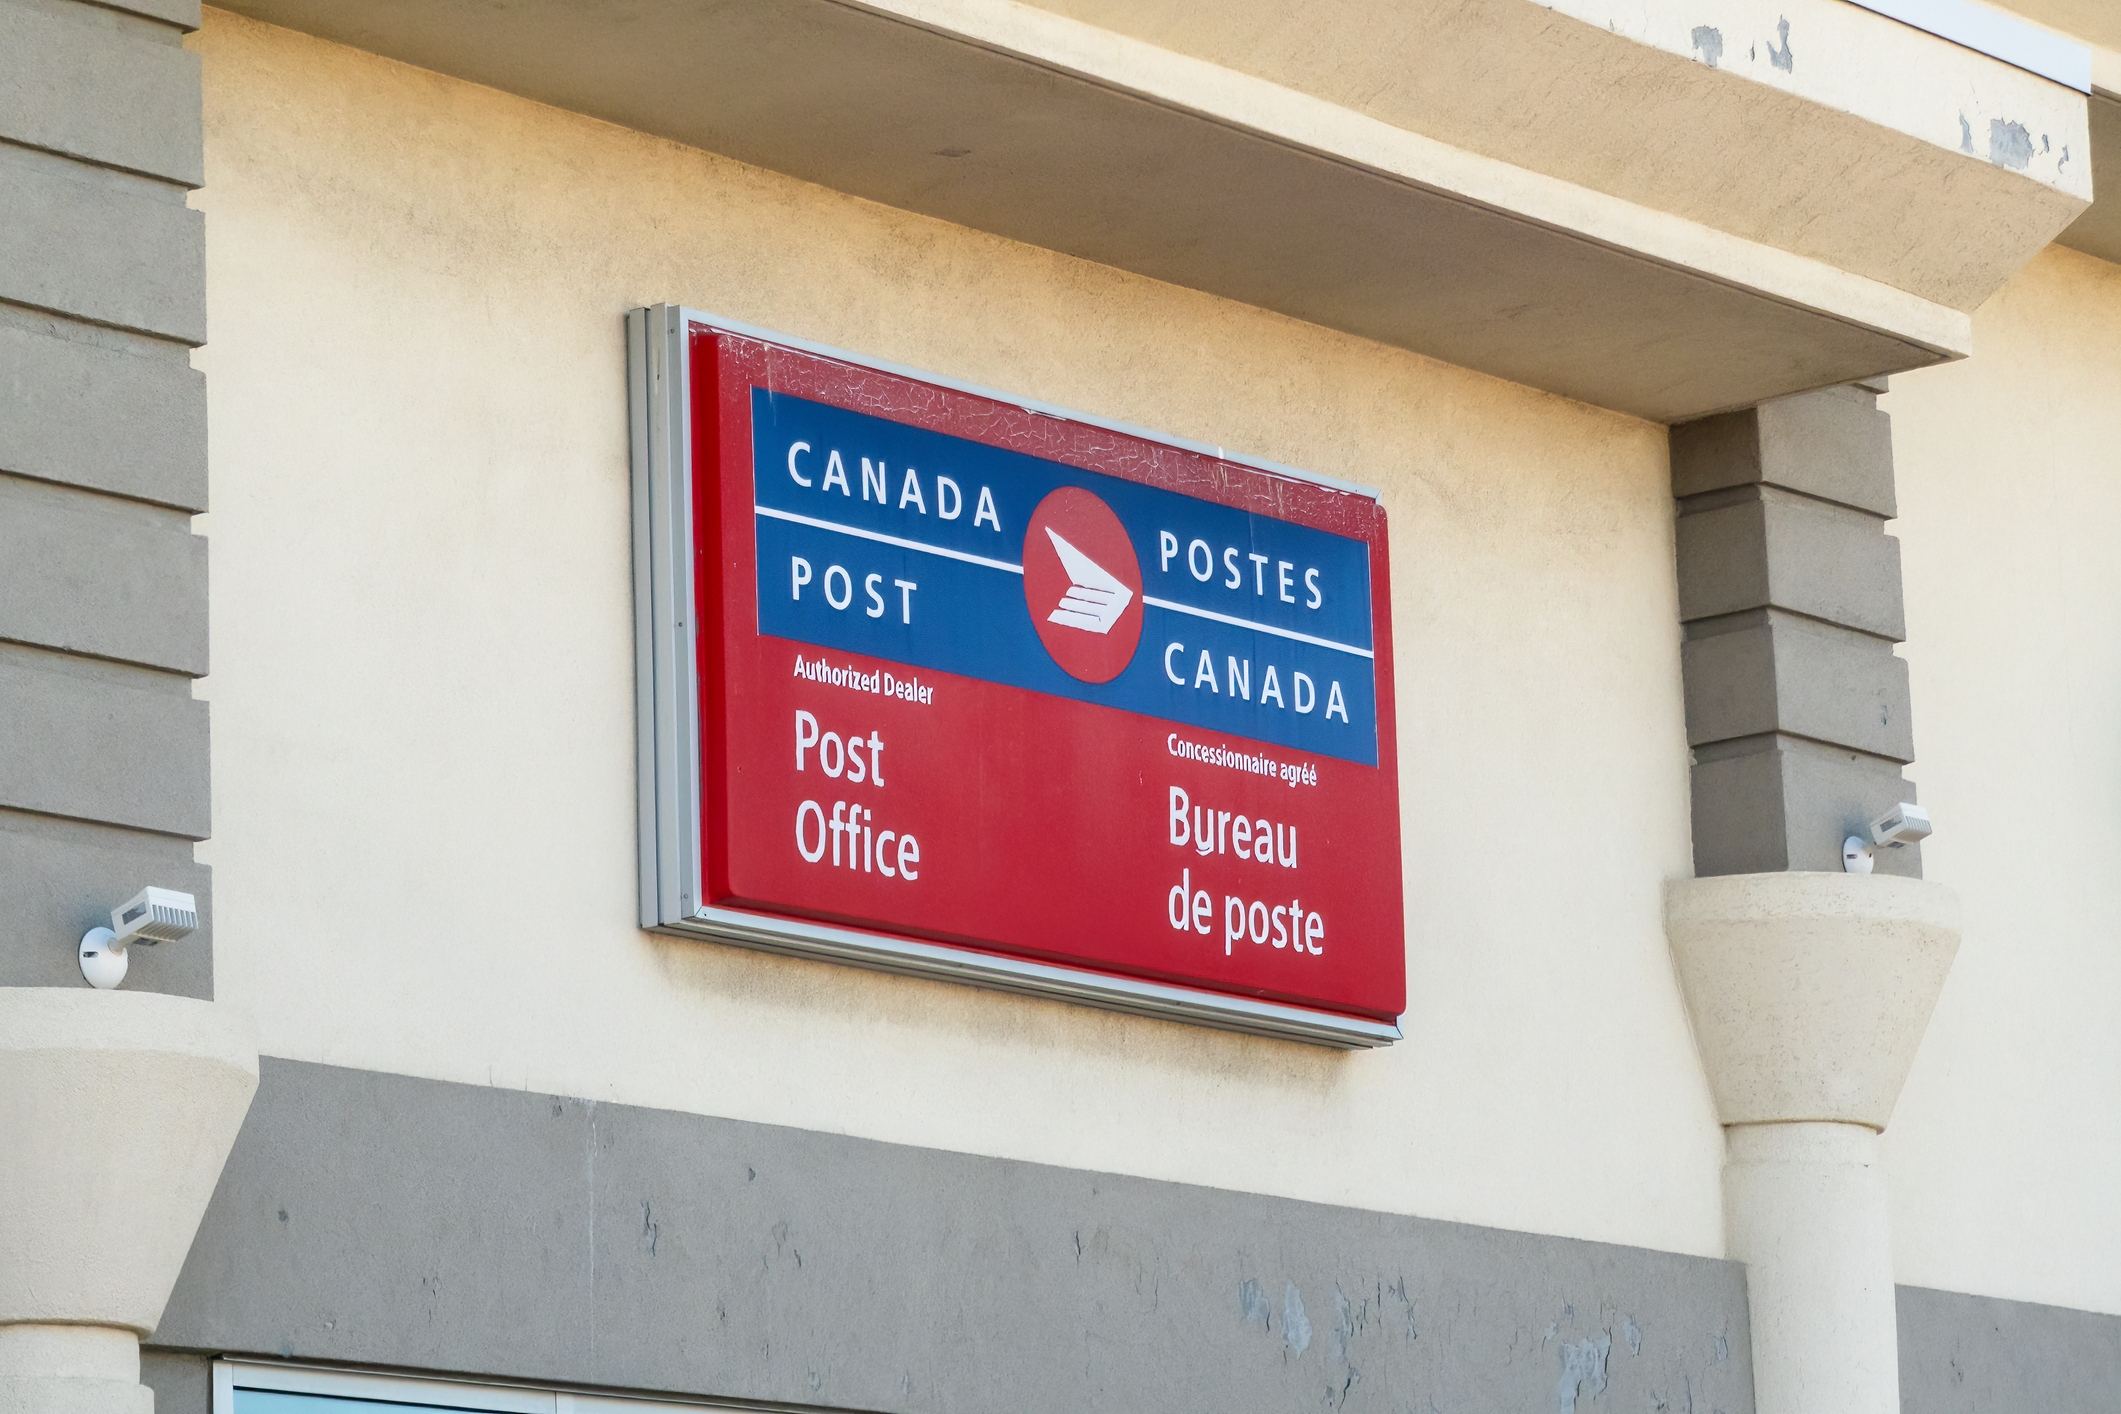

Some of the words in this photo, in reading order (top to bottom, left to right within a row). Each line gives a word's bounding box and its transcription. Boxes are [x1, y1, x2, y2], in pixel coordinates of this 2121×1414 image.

[786, 439, 1002, 533] CANADA
[790, 554, 918, 626] POST
[1159, 529, 1323, 611] POSTES
[793, 653, 880, 696] Authorized
[882, 671, 935, 706] Dealer
[1163, 641, 1350, 725] CANADA
[794, 708, 886, 789] Post
[1167, 732, 1277, 779] Concessionnaire
[1279, 760, 1319, 790] agréé
[795, 798, 921, 882] Office
[1168, 784, 1299, 870] Bureau
[1167, 866, 1214, 936] de
[1223, 894, 1326, 957] poste
